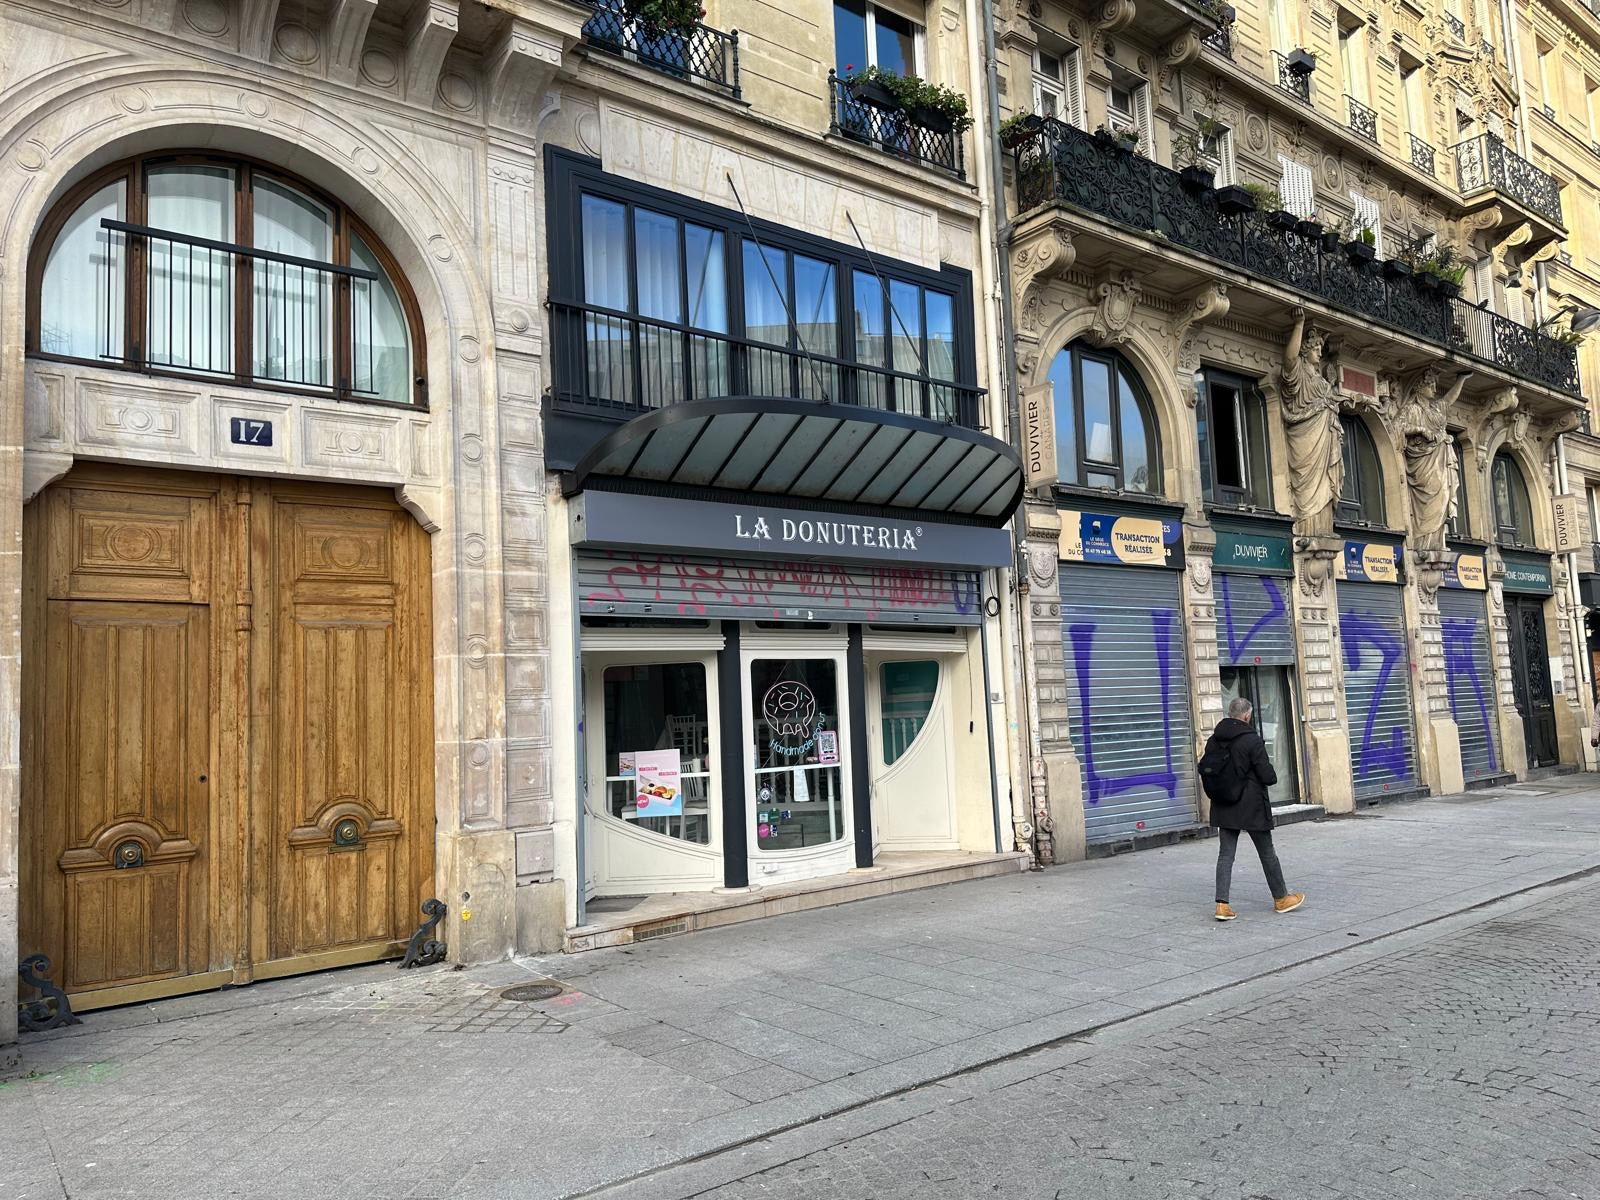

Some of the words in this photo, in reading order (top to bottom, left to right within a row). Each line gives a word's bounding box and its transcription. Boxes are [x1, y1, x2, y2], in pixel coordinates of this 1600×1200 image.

[239, 420, 265, 443] 17
[1028, 400, 1041, 473] DUVIVIER
[735, 515, 772, 540] LA
[1556, 503, 1568, 546] DUVIVIER
[1115, 532, 1160, 543] TRANSACTION
[1124, 544, 1153, 554] RÉALISÉE
[1235, 544, 1268, 557] DUVIVIER
[1365, 556, 1393, 565] TRANSACTION
[769, 738, 814, 756] Handmade
[812, 712, 826, 740] donut
